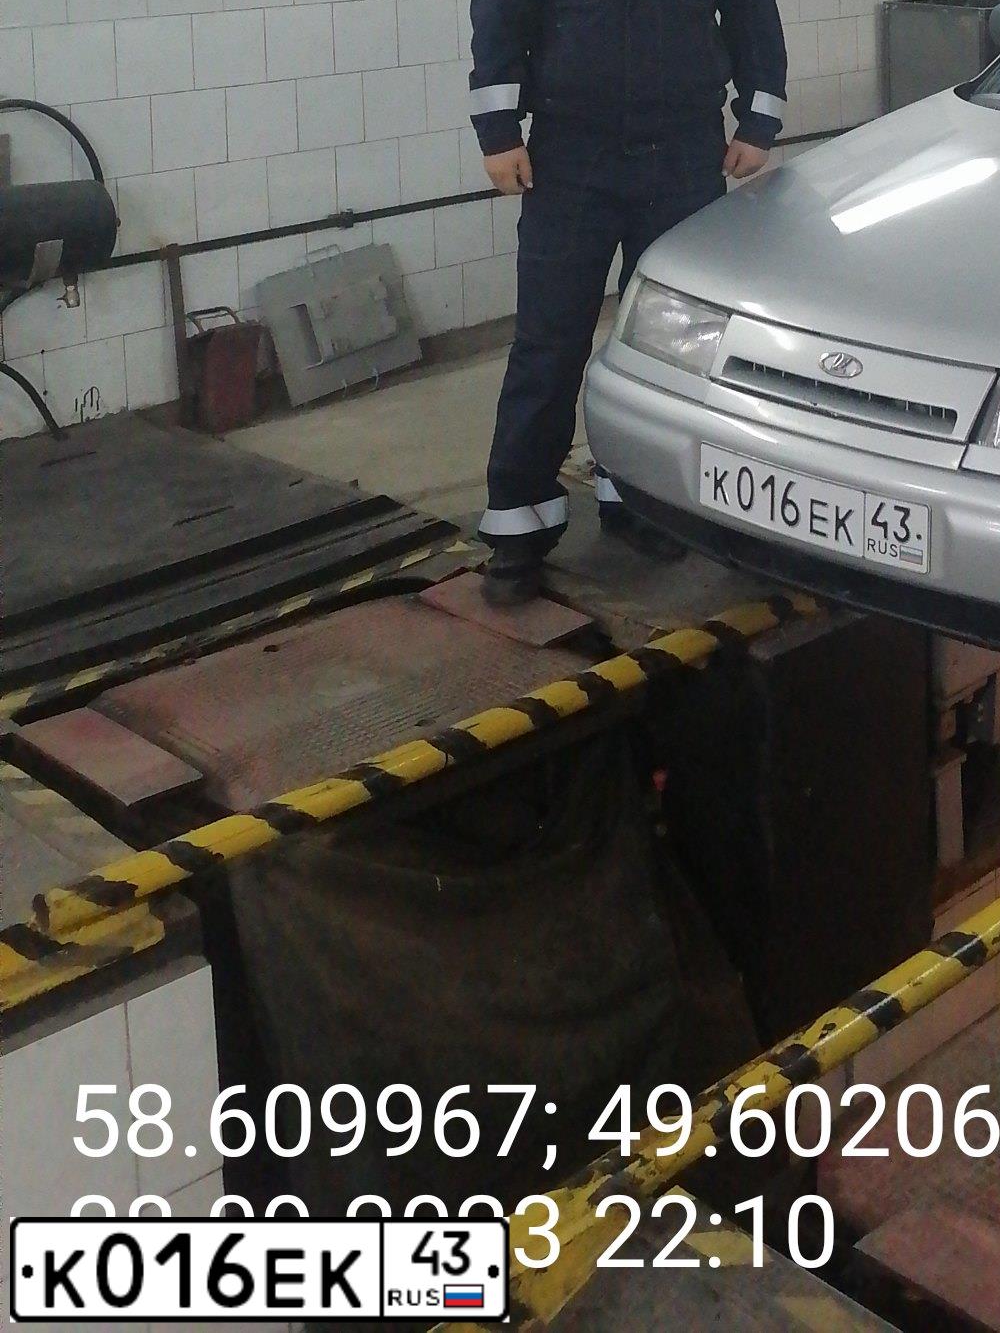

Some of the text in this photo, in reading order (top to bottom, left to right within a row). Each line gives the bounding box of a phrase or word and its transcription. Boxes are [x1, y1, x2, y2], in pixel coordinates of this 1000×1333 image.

[713, 465, 912, 546] К016ЕК 43
[867, 538, 899, 559] RUS
